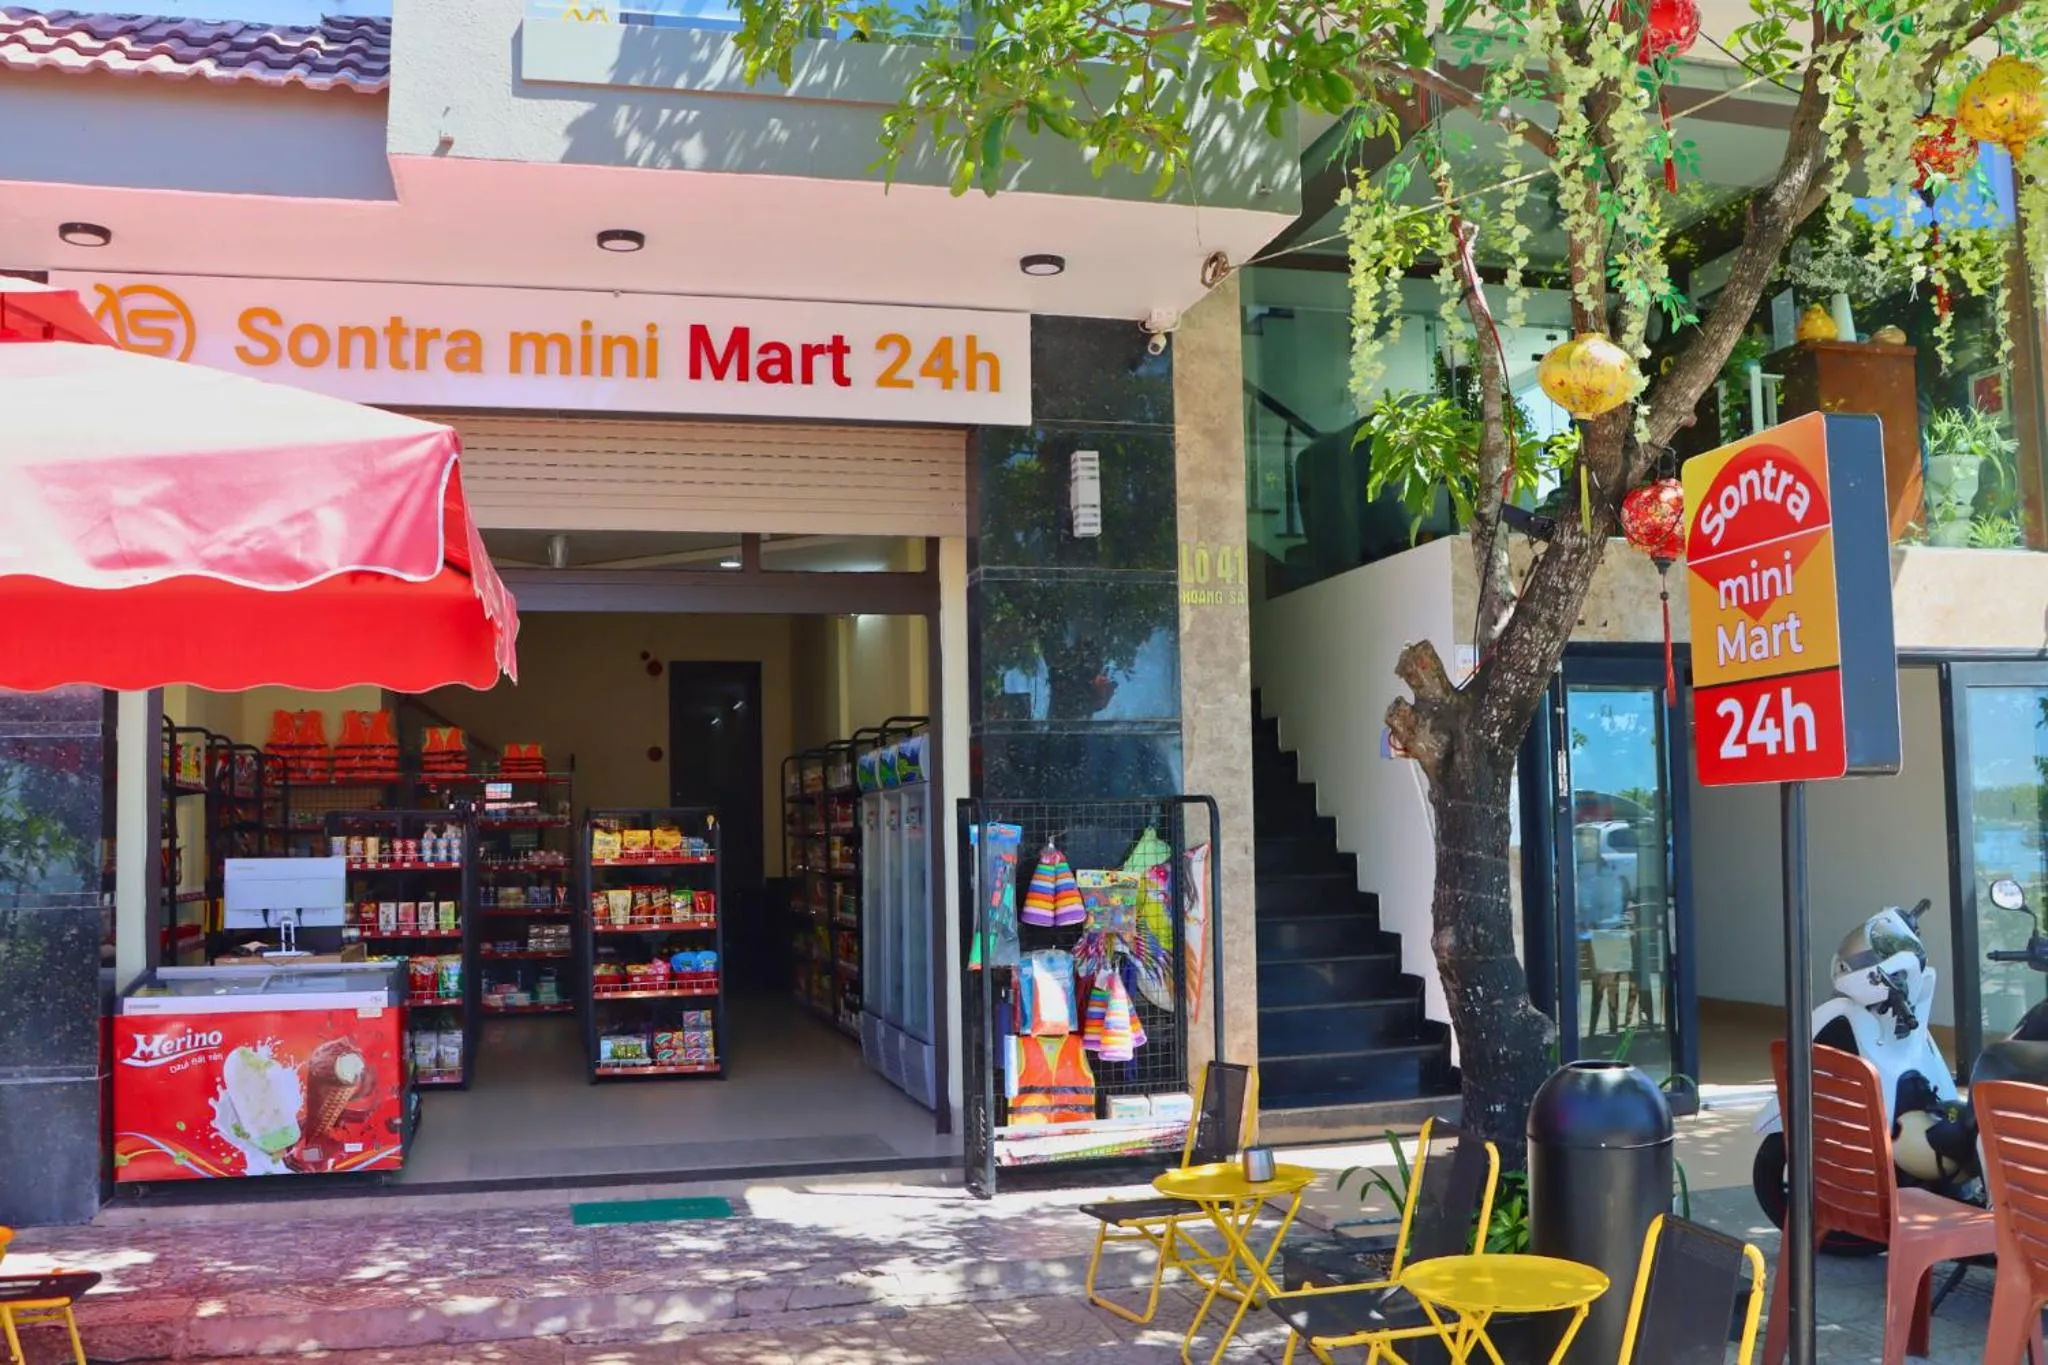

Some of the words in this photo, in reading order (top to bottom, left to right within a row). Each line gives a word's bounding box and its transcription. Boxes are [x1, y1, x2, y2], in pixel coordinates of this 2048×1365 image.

[235, 306, 485, 374] Sontra
[509, 319, 660, 380] mini
[689, 324, 852, 387] Mart
[874, 332, 1002, 394] 24h
[1700, 459, 1810, 547] Sontra
[1217, 545, 1245, 585] 41
[1718, 550, 1794, 610] mini
[1716, 612, 1804, 667] Mart
[1715, 687, 1818, 760] 24h
[131, 1027, 224, 1060] Merino
